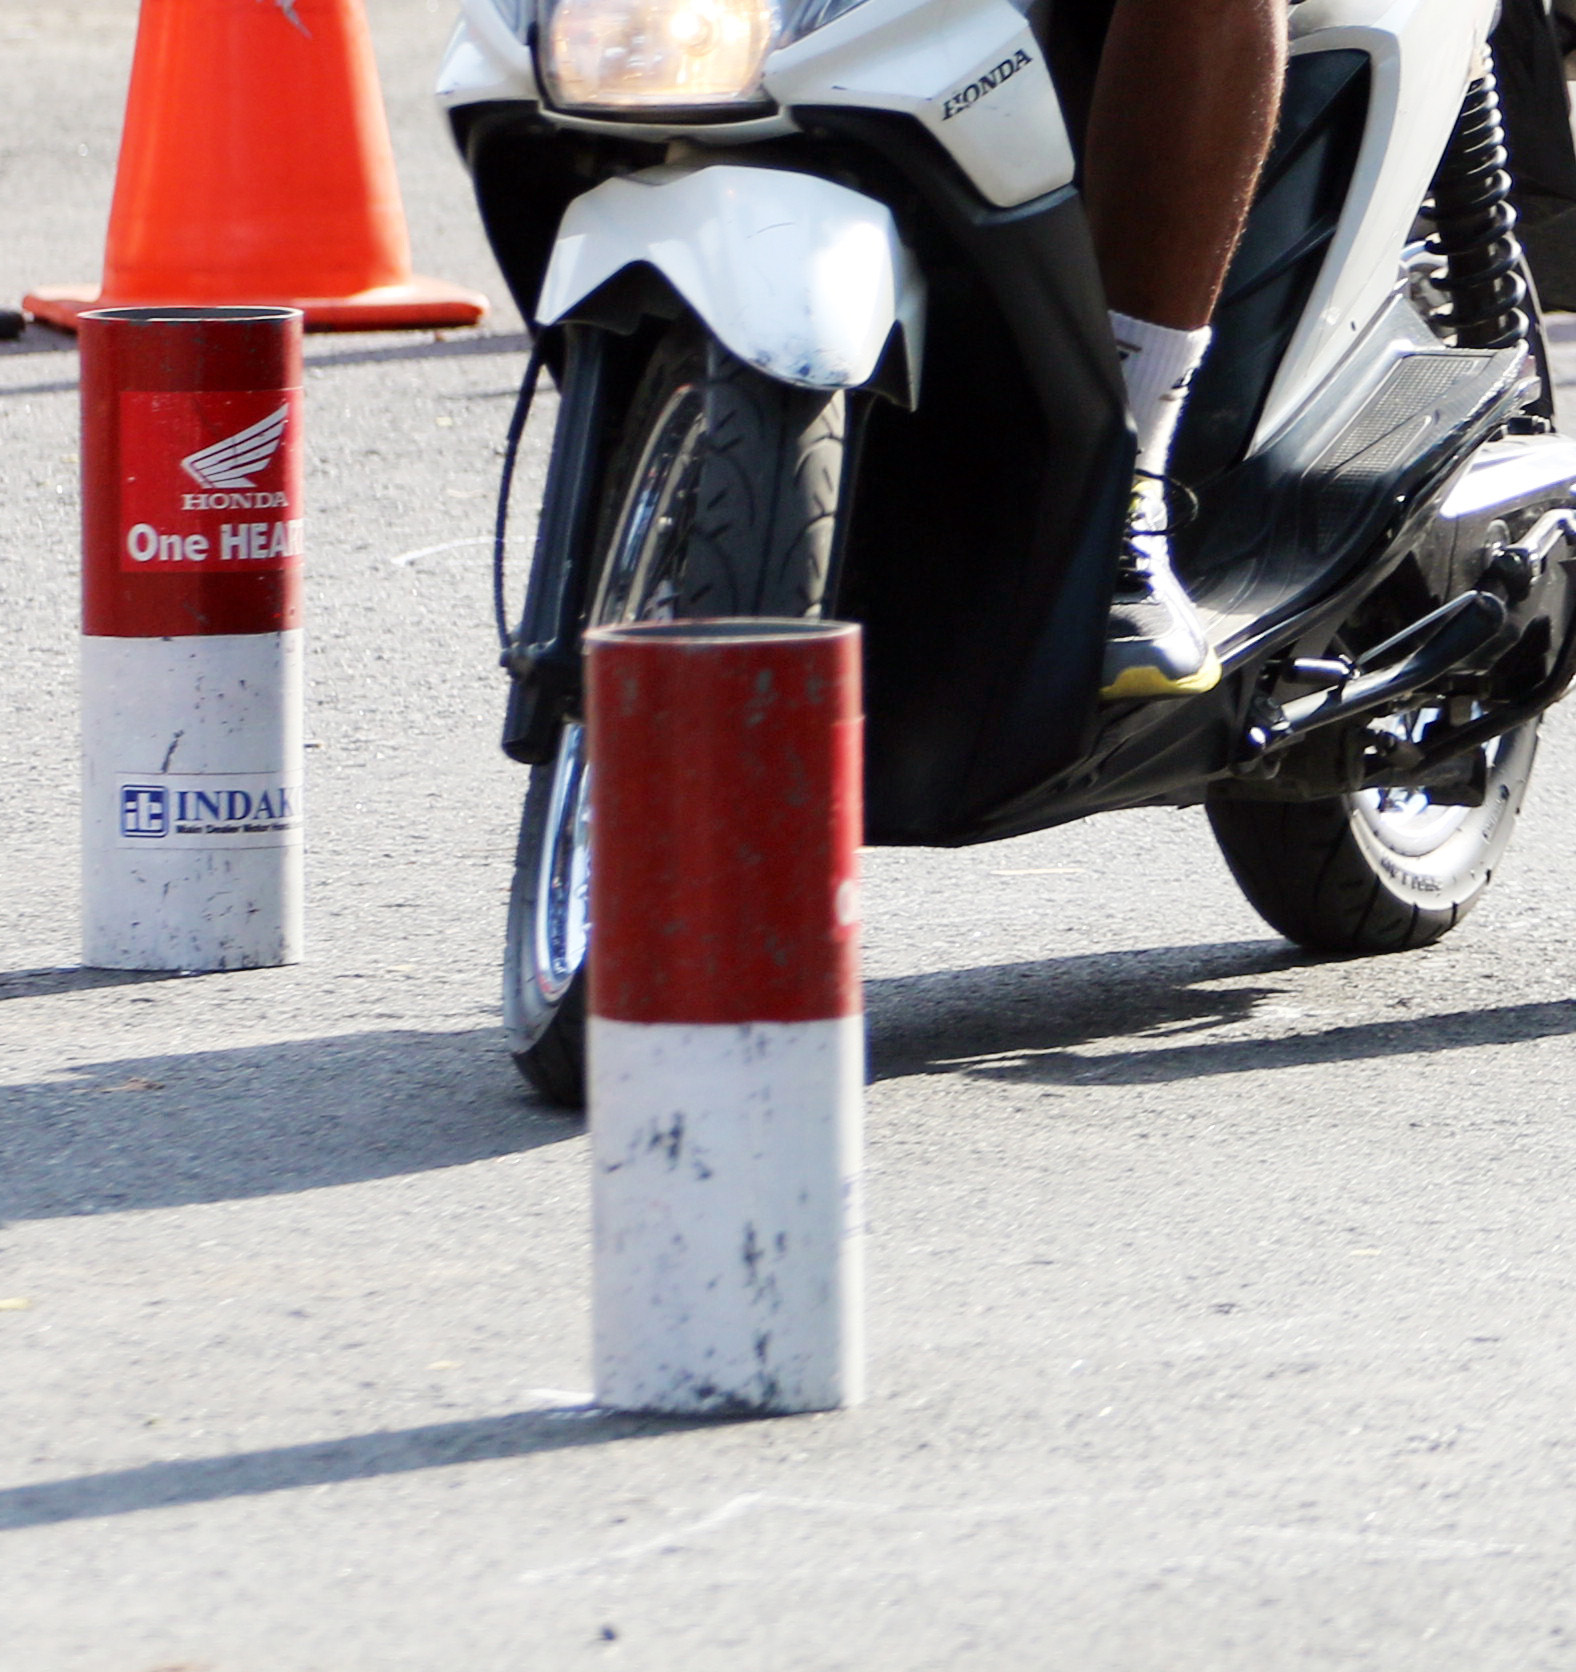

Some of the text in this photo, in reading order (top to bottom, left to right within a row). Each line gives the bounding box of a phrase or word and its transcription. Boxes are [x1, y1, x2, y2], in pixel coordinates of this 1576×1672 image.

[942, 48, 1033, 121] HONDA
[181, 491, 289, 511] HONDA
[127, 523, 209, 562] One
